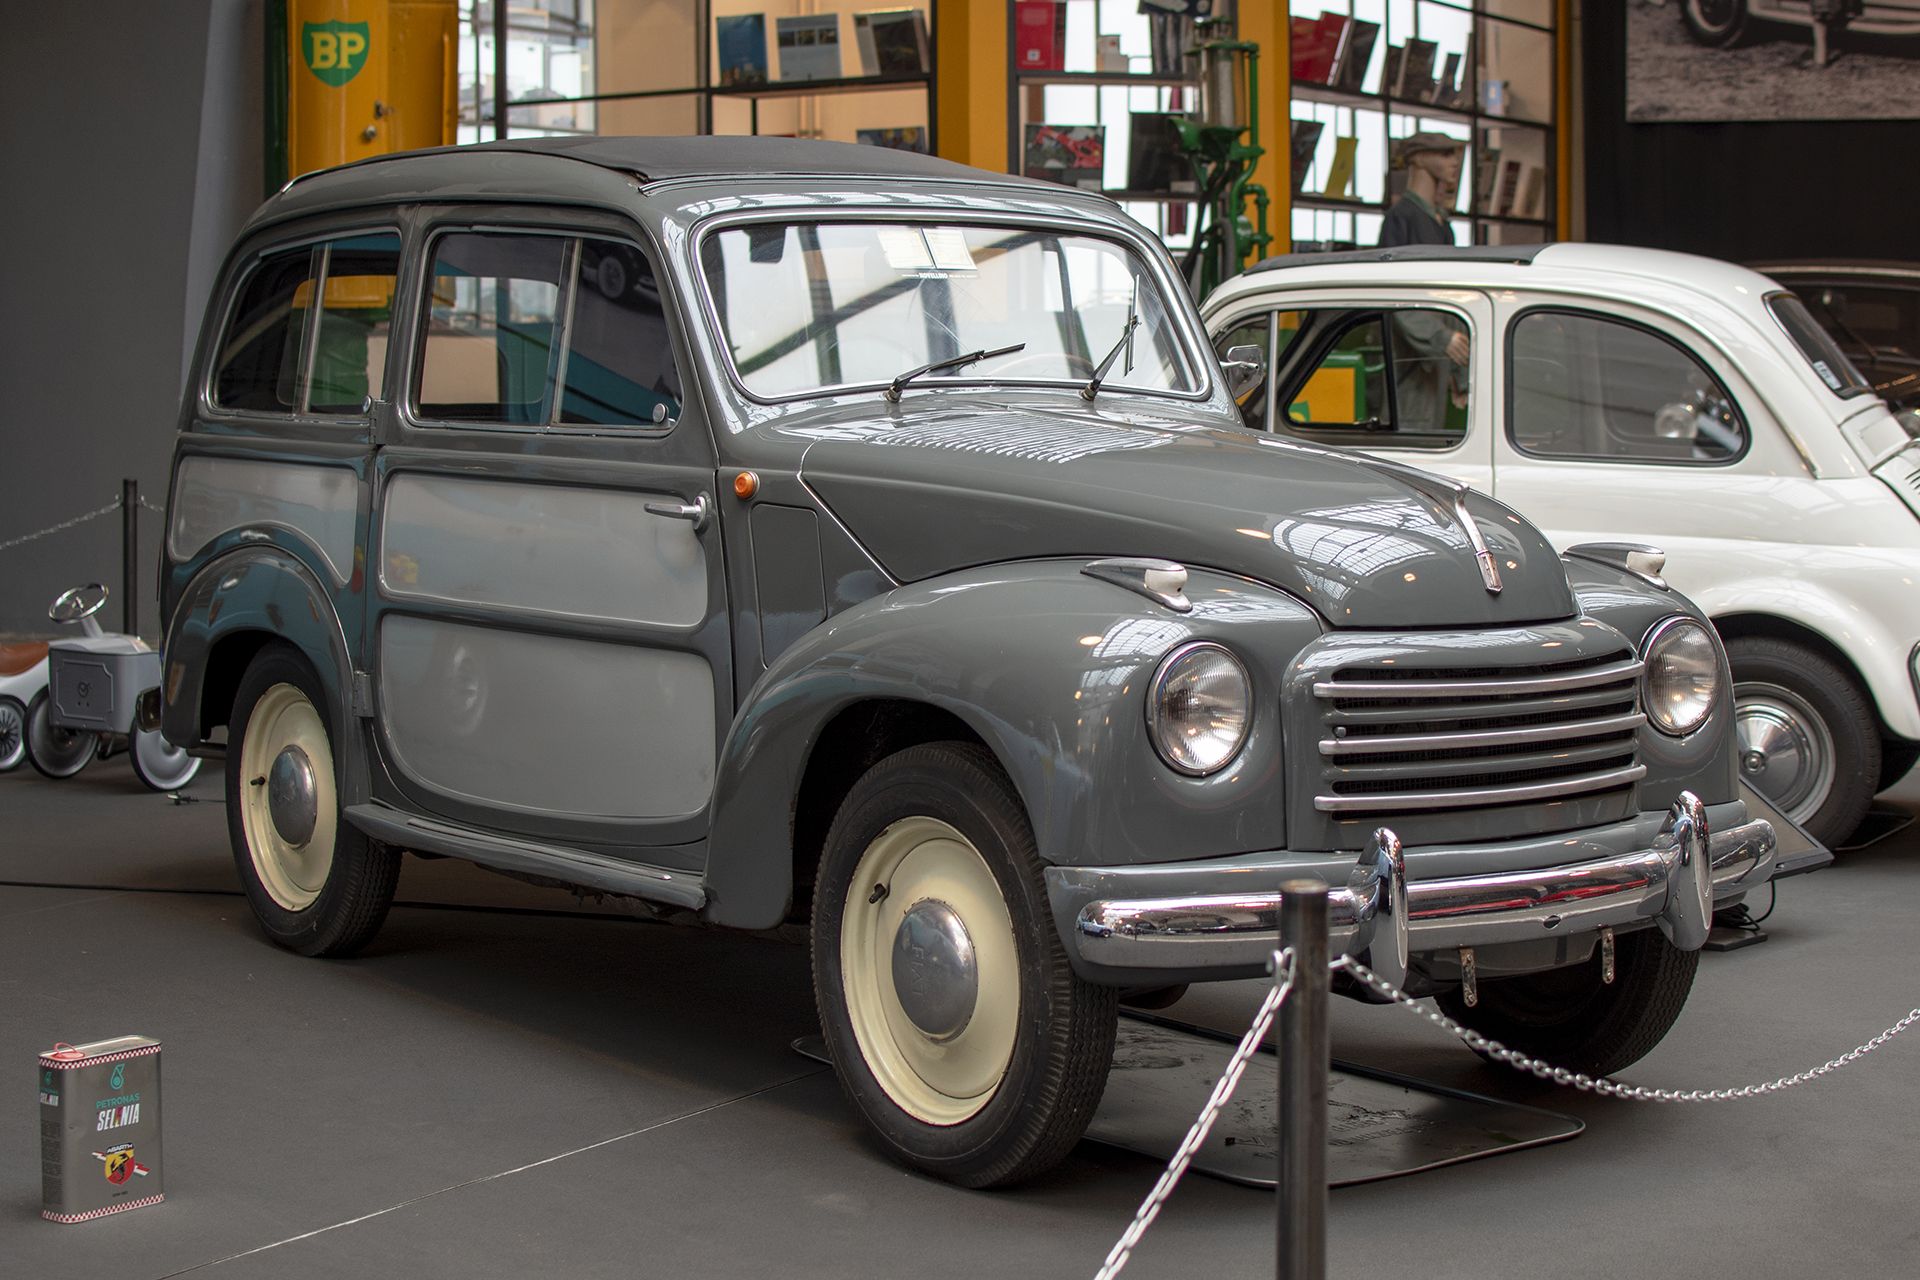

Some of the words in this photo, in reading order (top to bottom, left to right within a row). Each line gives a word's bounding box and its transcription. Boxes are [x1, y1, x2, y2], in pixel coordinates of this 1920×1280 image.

[310, 32, 365, 69] BP
[911, 943, 924, 997] FIAT
[96, 1093, 140, 1109] PETRONAS
[97, 1103, 140, 1131] SELENIA
[107, 1143, 133, 1153] ABARTH
